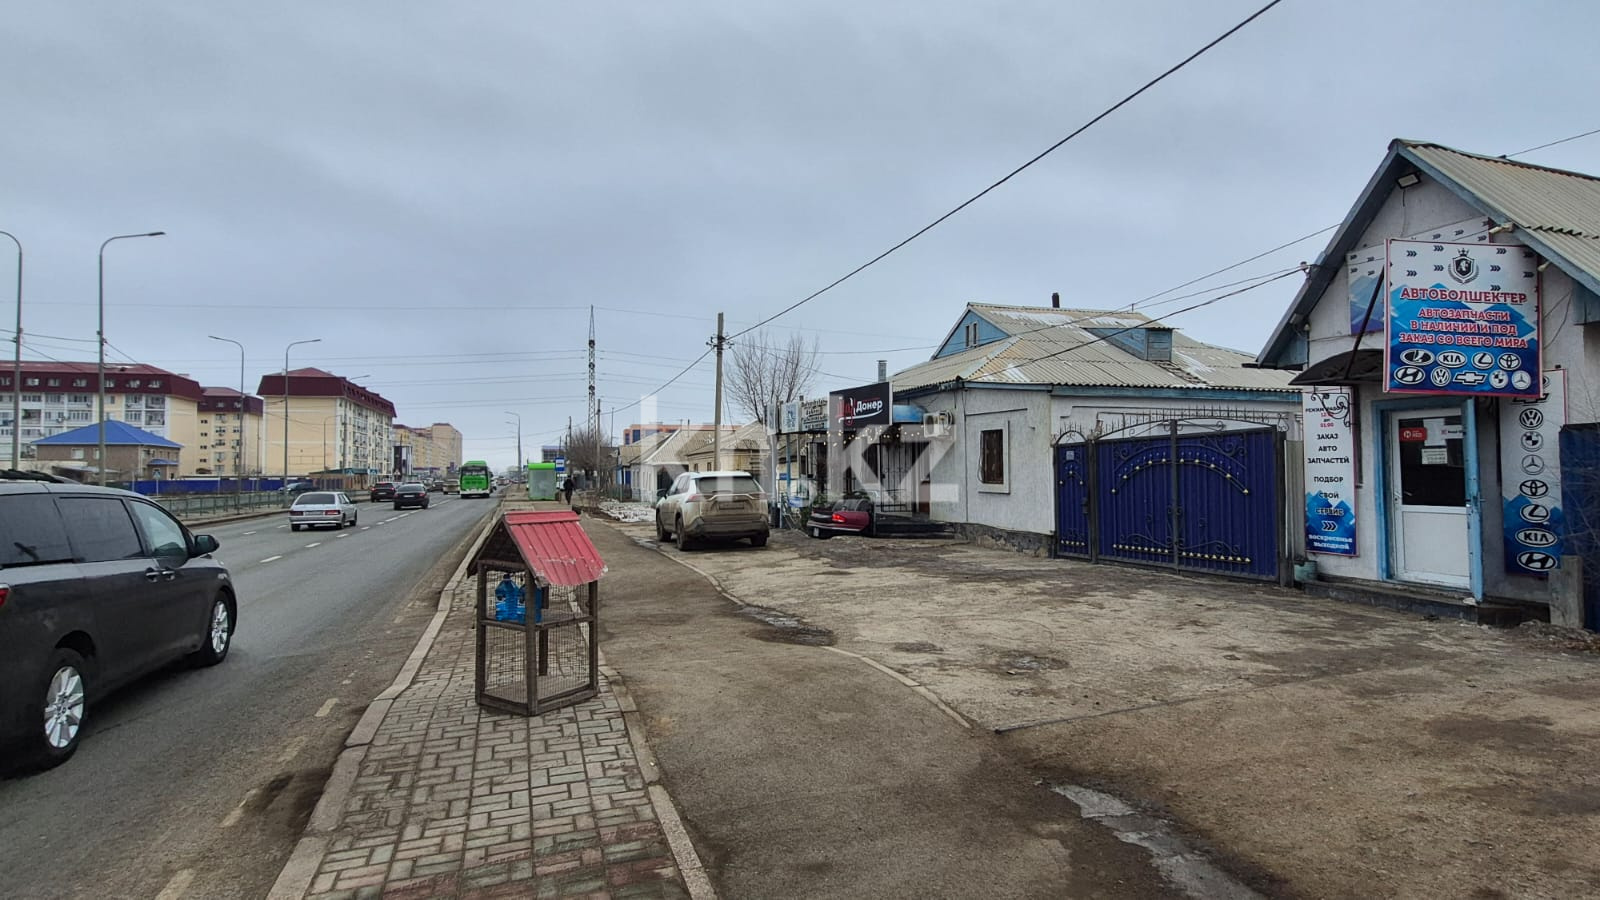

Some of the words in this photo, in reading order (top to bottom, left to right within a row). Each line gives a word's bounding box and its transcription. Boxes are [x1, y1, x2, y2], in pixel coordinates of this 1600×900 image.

[1400, 287, 1527, 303] АВТОБОЛШЕКТЕР
[1419, 308, 1510, 320] АВТОЗАПЧАСТИ
[1411, 321, 1418, 330] В
[1421, 321, 1477, 333] НАЛИЧИИ
[1480, 323, 1489, 333] И
[1492, 324, 1518, 336] ПОД
[1399, 333, 1434, 344] ЗАКАЗ
[1437, 335, 1454, 346] СО
[1456, 336, 1492, 347] ВСЕГО
[1495, 337, 1528, 348] МИРА
[1442, 354, 1462, 363] KIA
[856, 399, 883, 413] Донер
[1307, 456, 1350, 464] ЗАПЧАСТЕЙ
[1319, 491, 1339, 499] СВОЙ
[1315, 508, 1345, 516] СЕРВИС
[1523, 532, 1549, 543] KIA
